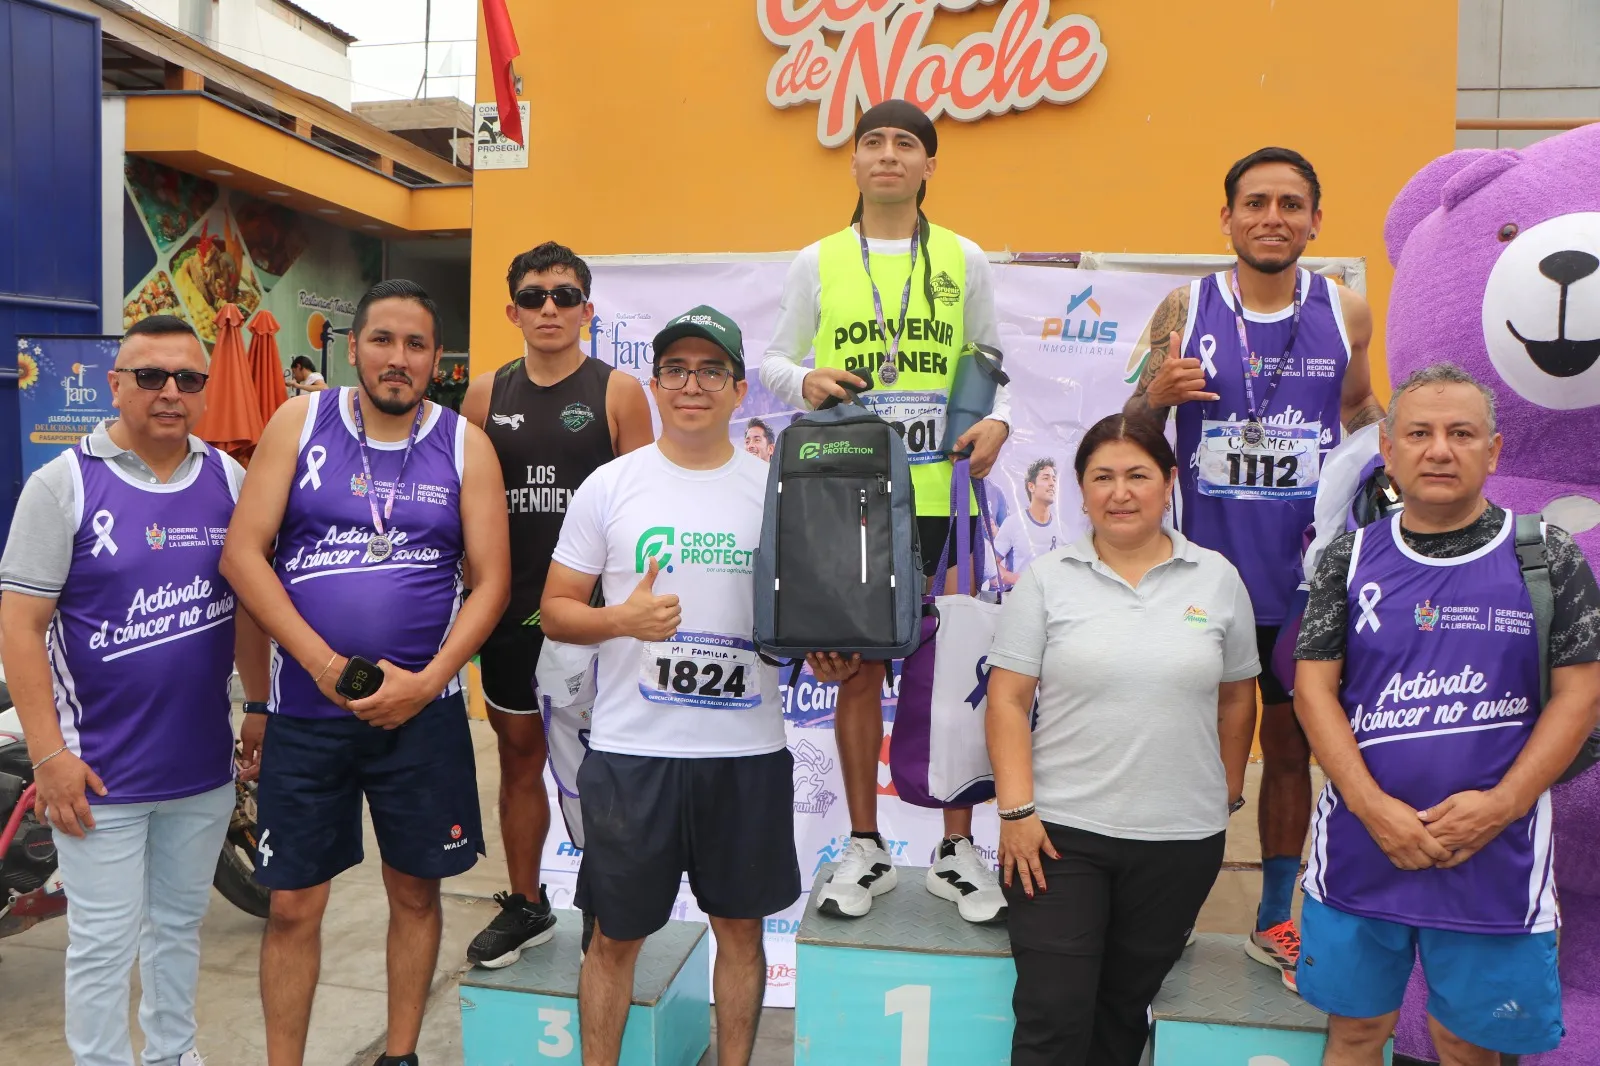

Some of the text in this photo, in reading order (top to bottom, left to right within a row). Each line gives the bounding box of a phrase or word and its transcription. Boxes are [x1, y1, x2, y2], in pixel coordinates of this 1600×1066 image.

[775, 0, 1098, 137] de Noche
[477, 144, 526, 153] PROSEGUR
[834, 318, 954, 350] PORVENIR
[1040, 317, 1119, 345] PLUS
[1038, 343, 1115, 356] INMOBILIARIA
[867, 396, 880, 405] 7K
[1221, 428, 1232, 436] 7K
[822, 440, 850, 449] CROPS
[822, 447, 874, 455] PROTECTION
[526, 465, 556, 485] LOS
[1226, 453, 1299, 487] 1112
[417, 490, 448, 500] REGIONAL
[418, 484, 450, 494] GERENCIA
[427, 497, 447, 506] SALUD
[314, 524, 409, 551] Actívte
[680, 532, 736, 548] CROPS
[301, 546, 361, 570] cáncer
[680, 548, 752, 567] PROTECT
[126, 575, 213, 621] Actívate
[1442, 606, 1480, 614] GOBIERNO
[1495, 609, 1534, 620] GERENCIA
[1441, 614, 1478, 622] REGIONAL
[1494, 617, 1532, 628] REGIONAL
[89, 619, 109, 650] el
[113, 613, 175, 645] cáncer
[179, 605, 203, 629] no
[1440, 622, 1486, 630] LA LIBERTAD
[1494, 624, 1531, 636] DE SALUD
[694, 636, 720, 645] CORRO
[720, 638, 734, 646] POR
[671, 646, 729, 659] MI FAMILIA
[351, 669, 369, 691] 9:13
[656, 657, 746, 698] 1824
[1375, 664, 1488, 707] Actívate
[1361, 704, 1431, 732] cáncer
[1433, 700, 1468, 725] no
[443, 837, 469, 851] WALON
[884, 984, 932, 1066] 1
[537, 1009, 574, 1058] 3
